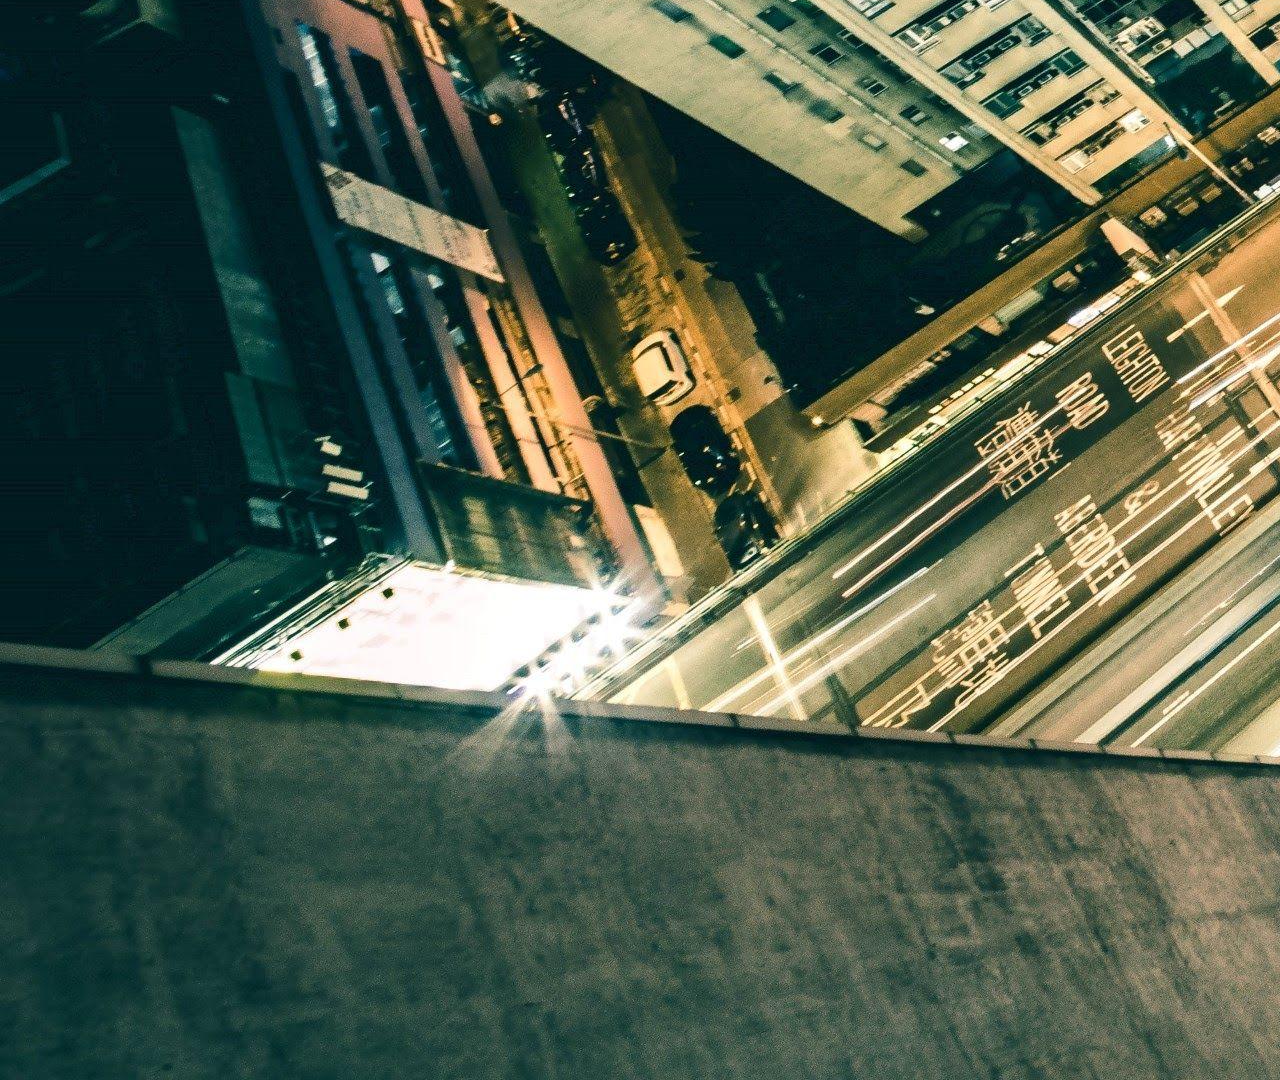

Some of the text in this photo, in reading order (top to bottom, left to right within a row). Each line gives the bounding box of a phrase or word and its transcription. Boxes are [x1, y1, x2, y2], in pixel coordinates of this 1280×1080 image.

[1054, 371, 1109, 430] ROAD
[1101, 324, 1171, 404] LEIGHTON
[973, 400, 1063, 500] 禮頓道
[1124, 480, 1160, 515] &
[1004, 542, 1071, 640] TUNNEL
[1053, 494, 1137, 607] ABERDEEN
[930, 599, 1011, 709] 跑馬地
